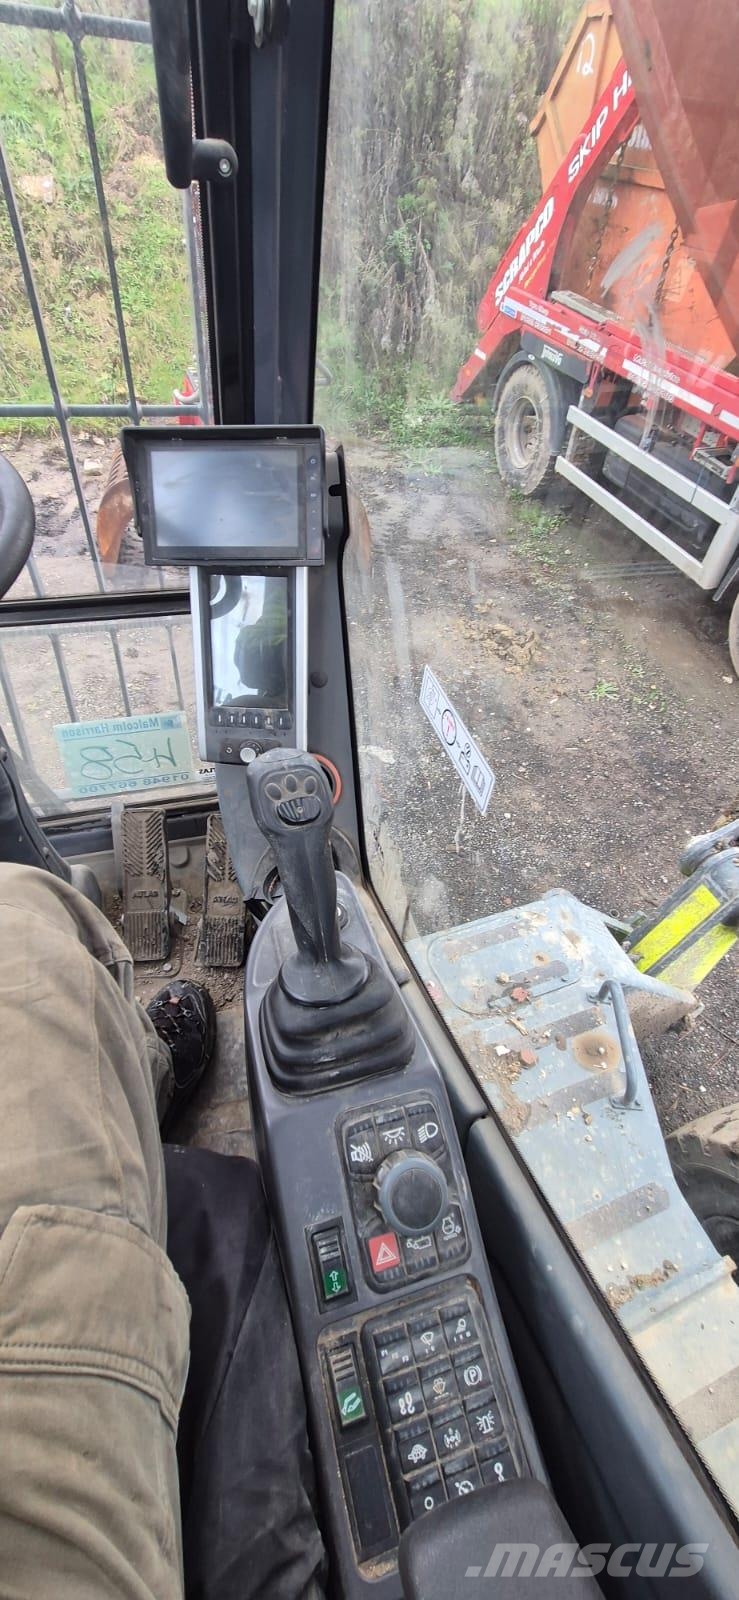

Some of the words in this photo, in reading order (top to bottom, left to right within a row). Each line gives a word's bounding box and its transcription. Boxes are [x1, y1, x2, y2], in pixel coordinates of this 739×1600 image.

[495, 197, 555, 306] SCRAPCO
[568, 106, 609, 183] SKIP
[132, 890, 159, 899] ATLAS
[213, 896, 239, 906] ATLAS
